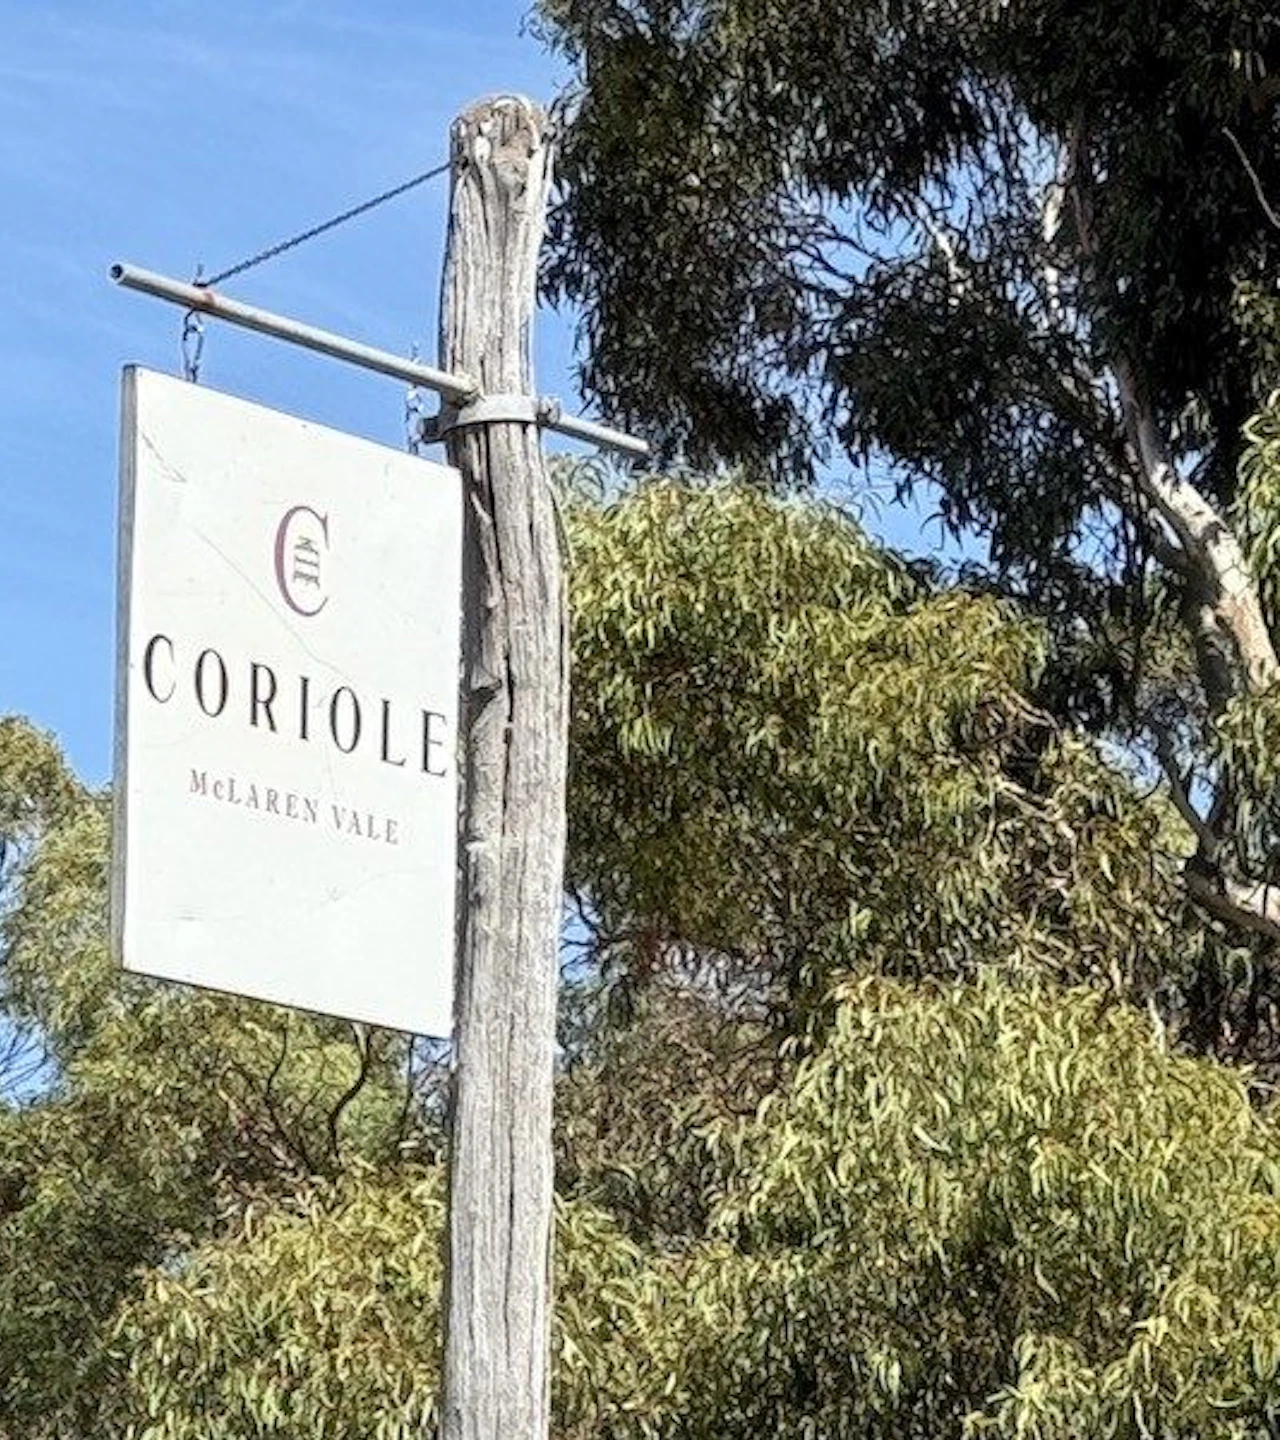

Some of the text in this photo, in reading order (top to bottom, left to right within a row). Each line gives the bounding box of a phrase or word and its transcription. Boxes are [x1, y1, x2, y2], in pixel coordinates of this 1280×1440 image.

[143, 633, 448, 778] CORIOLE
[189, 768, 399, 845] McLAREN VALE
